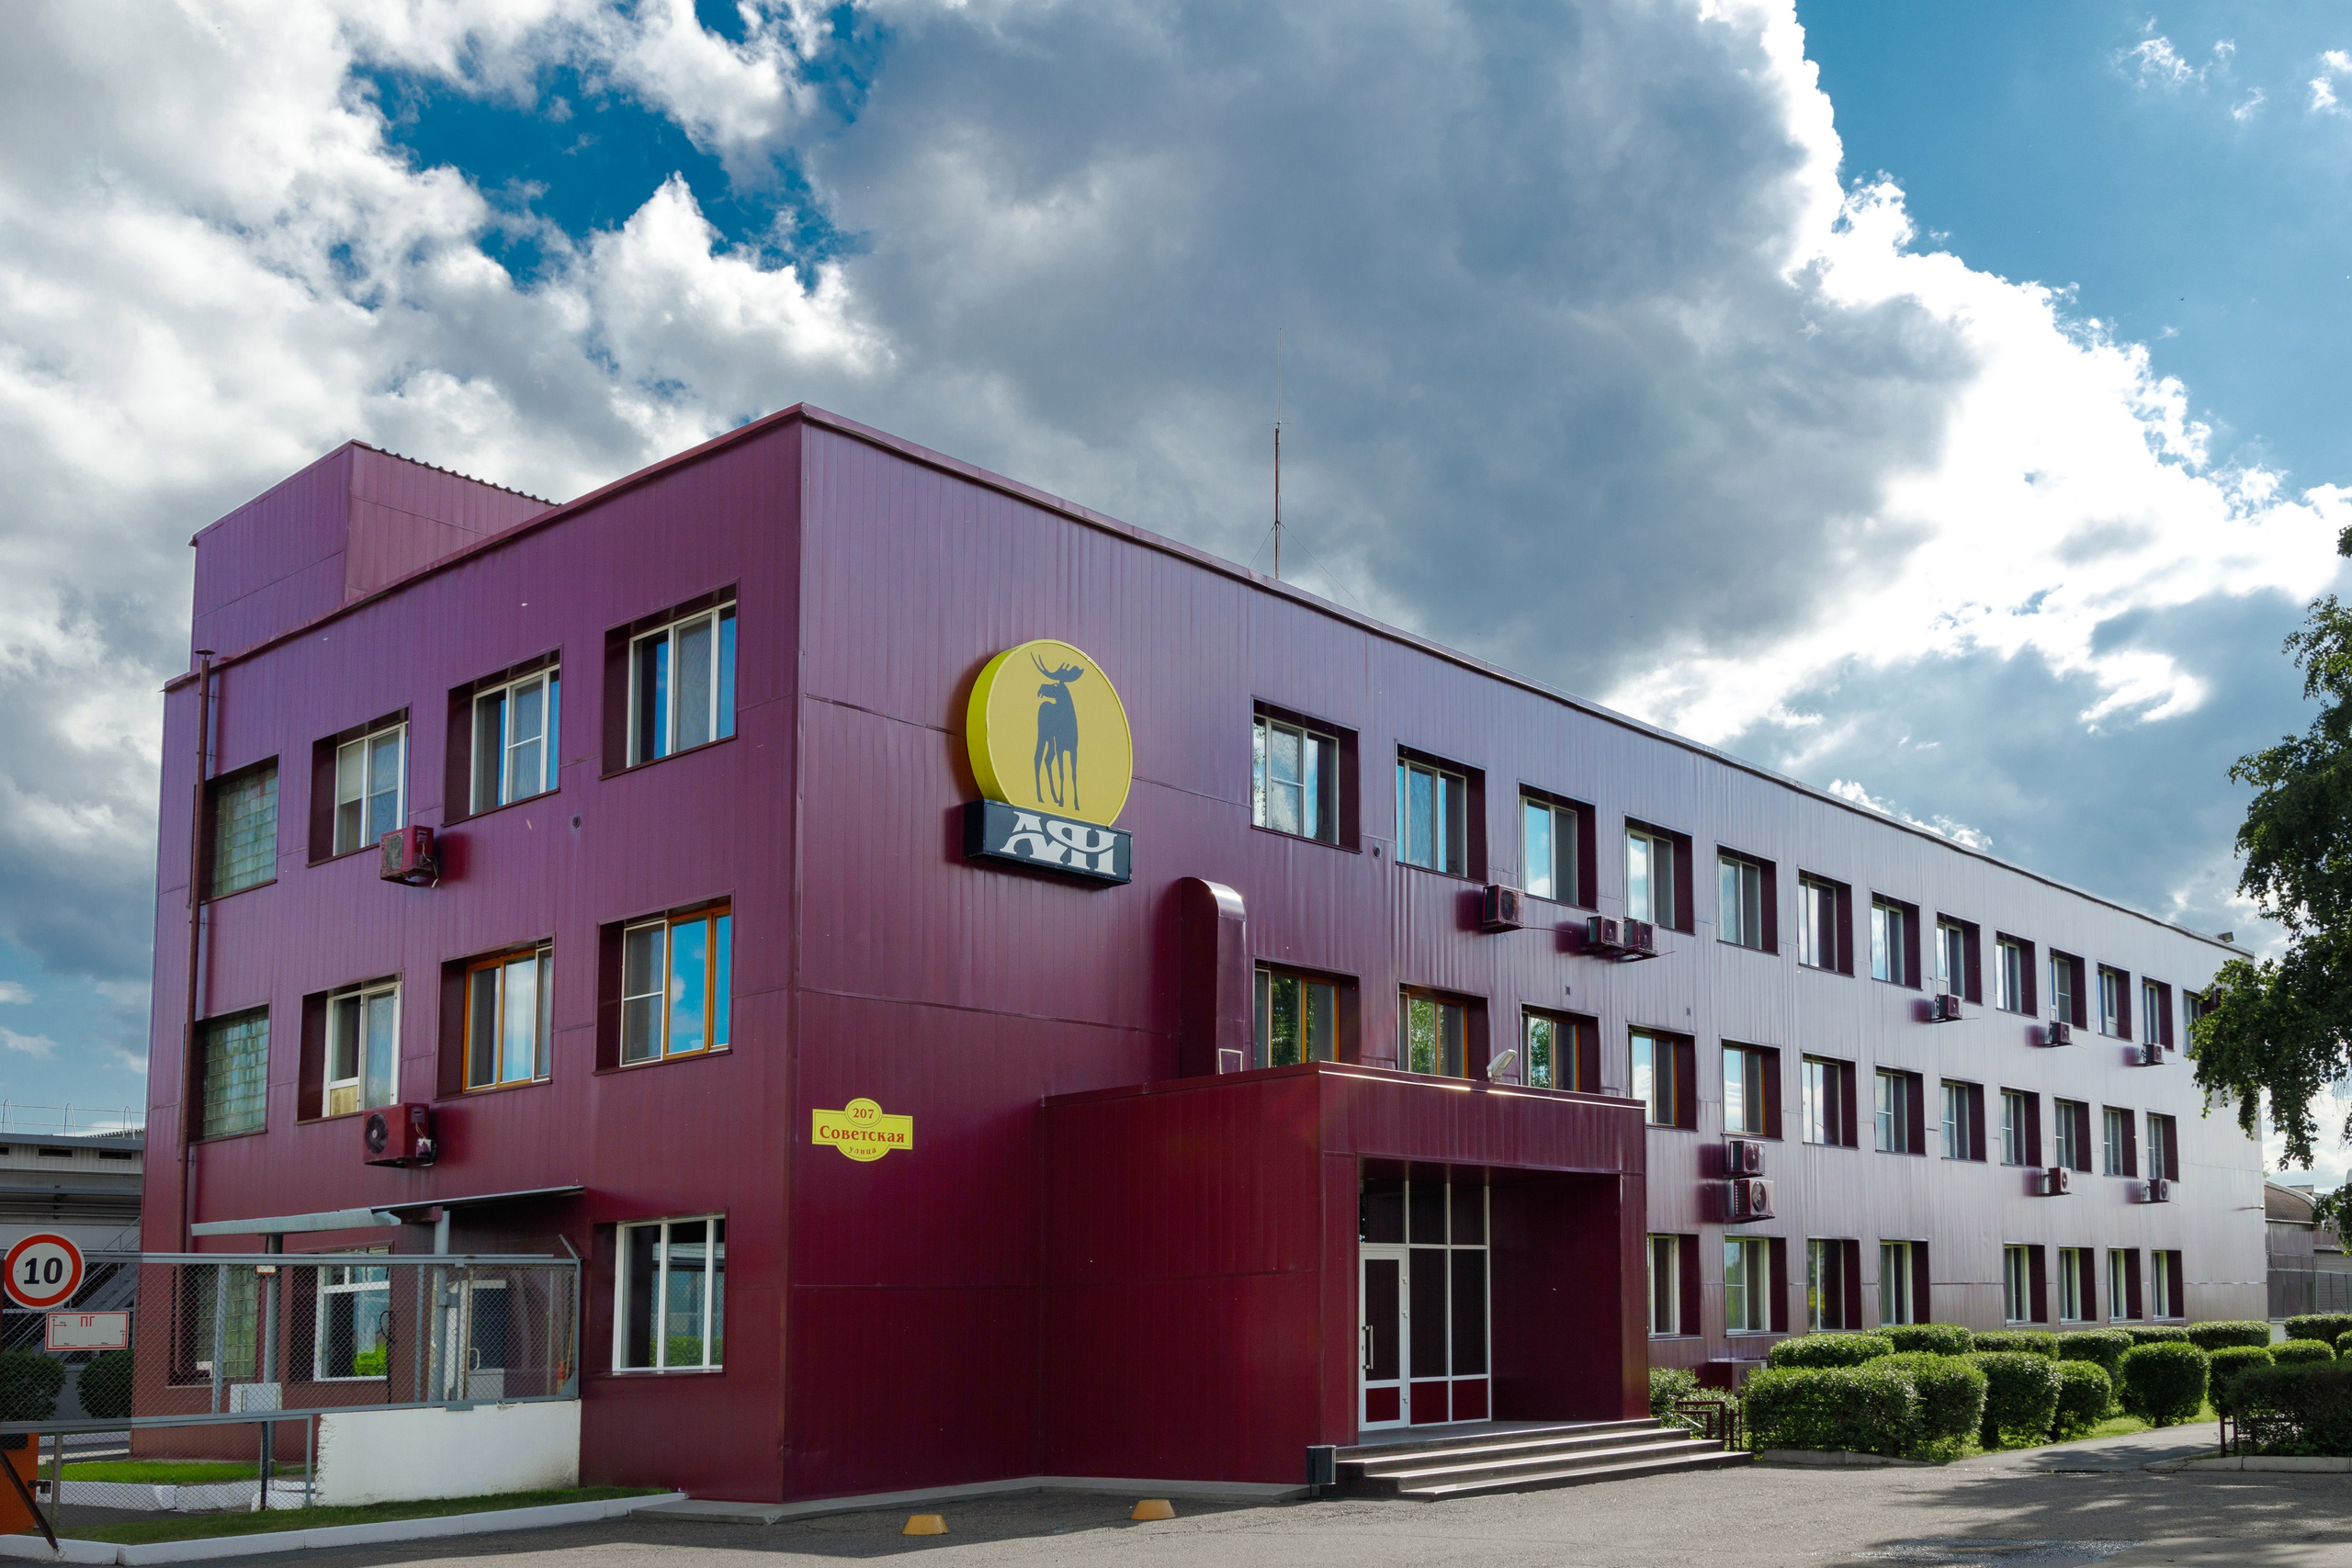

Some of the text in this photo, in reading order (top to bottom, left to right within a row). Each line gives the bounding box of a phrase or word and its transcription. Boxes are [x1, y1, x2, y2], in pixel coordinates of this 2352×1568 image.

[1000, 811, 1117, 875] АЯН
[853, 1108, 874, 1119] 207
[820, 1125, 905, 1143] Советская
[849, 1146, 876, 1156] улица
[24, 1258, 62, 1284] 10
[80, 1315, 96, 1327] ПГ
